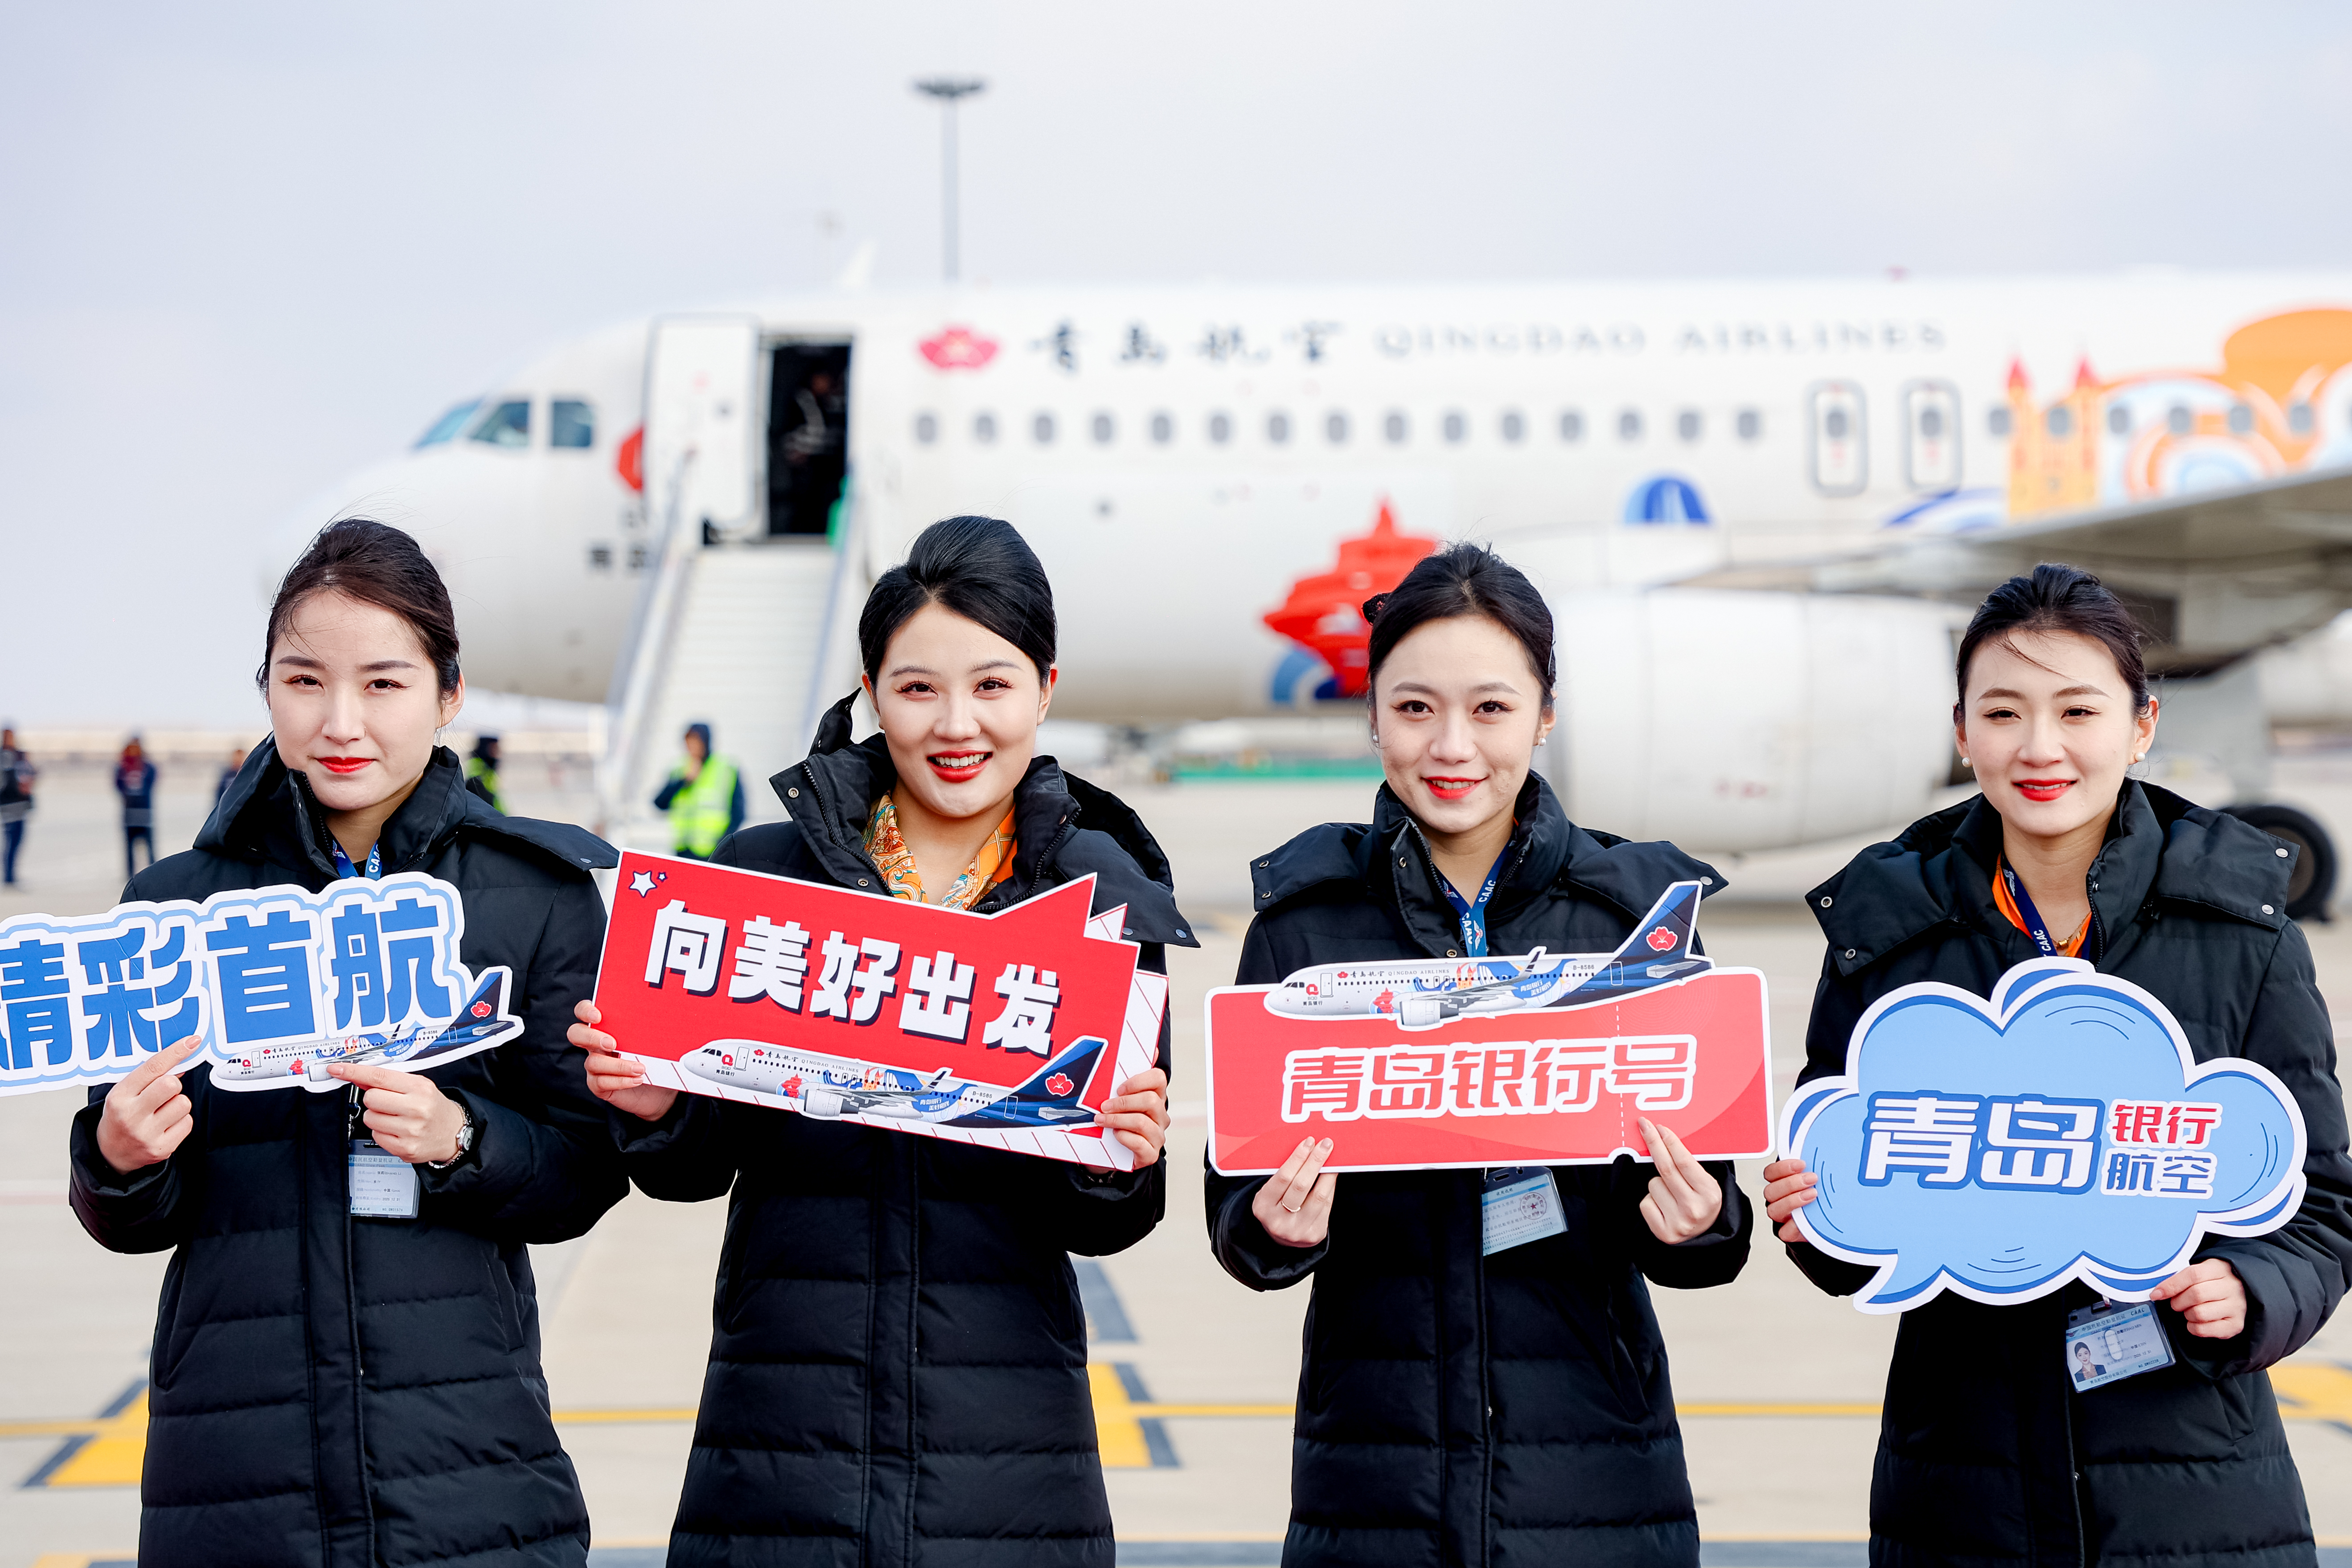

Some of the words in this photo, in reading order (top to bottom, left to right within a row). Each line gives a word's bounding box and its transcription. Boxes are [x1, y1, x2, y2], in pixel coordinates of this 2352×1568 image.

[1374, 322, 1645, 361] QINGDAO
[1676, 320, 1946, 356] AIRLINES
[1478, 880, 1496, 903] CAAC
[2034, 930, 2051, 951] CAAC
[644, 899, 1062, 1059] 向美好出发
[801, 1059, 829, 1068] QINGDAO
[832, 1064, 859, 1073] AIRLINES
[1289, 1042, 1689, 1115] 青岛银行号
[1865, 1097, 2098, 1188] 青岛
[2112, 1104, 2217, 1144] 银行
[2106, 1153, 2211, 1194] 航空
[2130, 1308, 2145, 1316] CAAC
